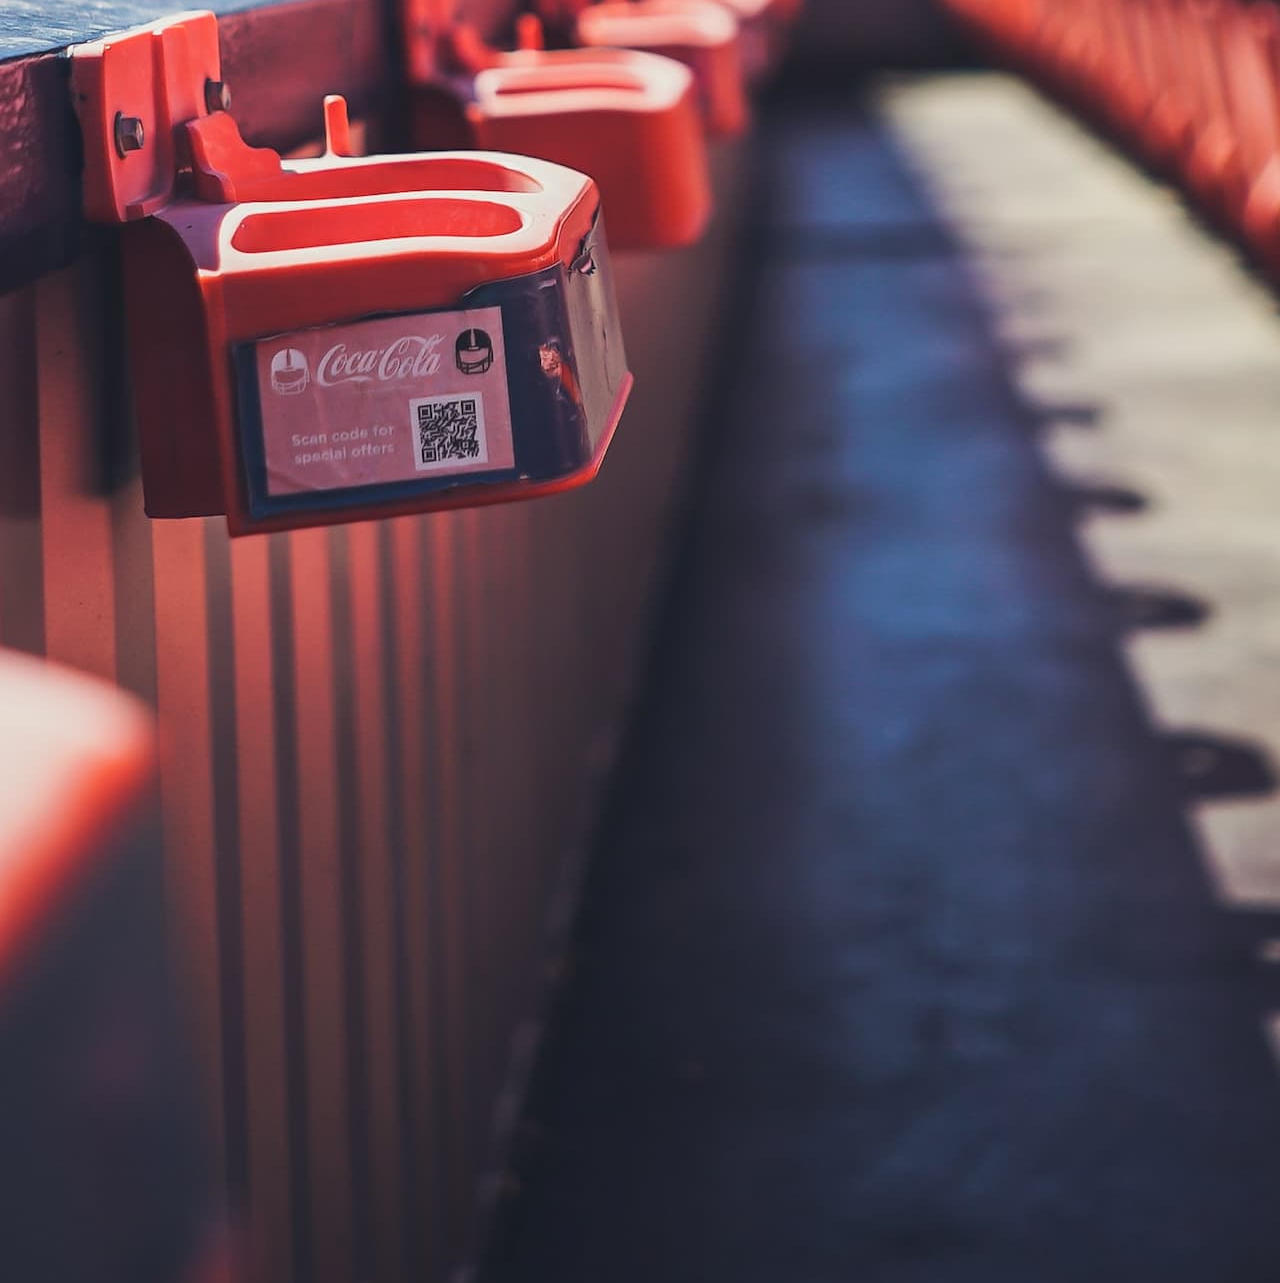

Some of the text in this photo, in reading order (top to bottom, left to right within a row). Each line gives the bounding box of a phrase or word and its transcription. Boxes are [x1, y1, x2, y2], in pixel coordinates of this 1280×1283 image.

[317, 333, 447, 386] Coca-Cola
[292, 424, 394, 447] Scan code for
[294, 443, 395, 465] special offers
